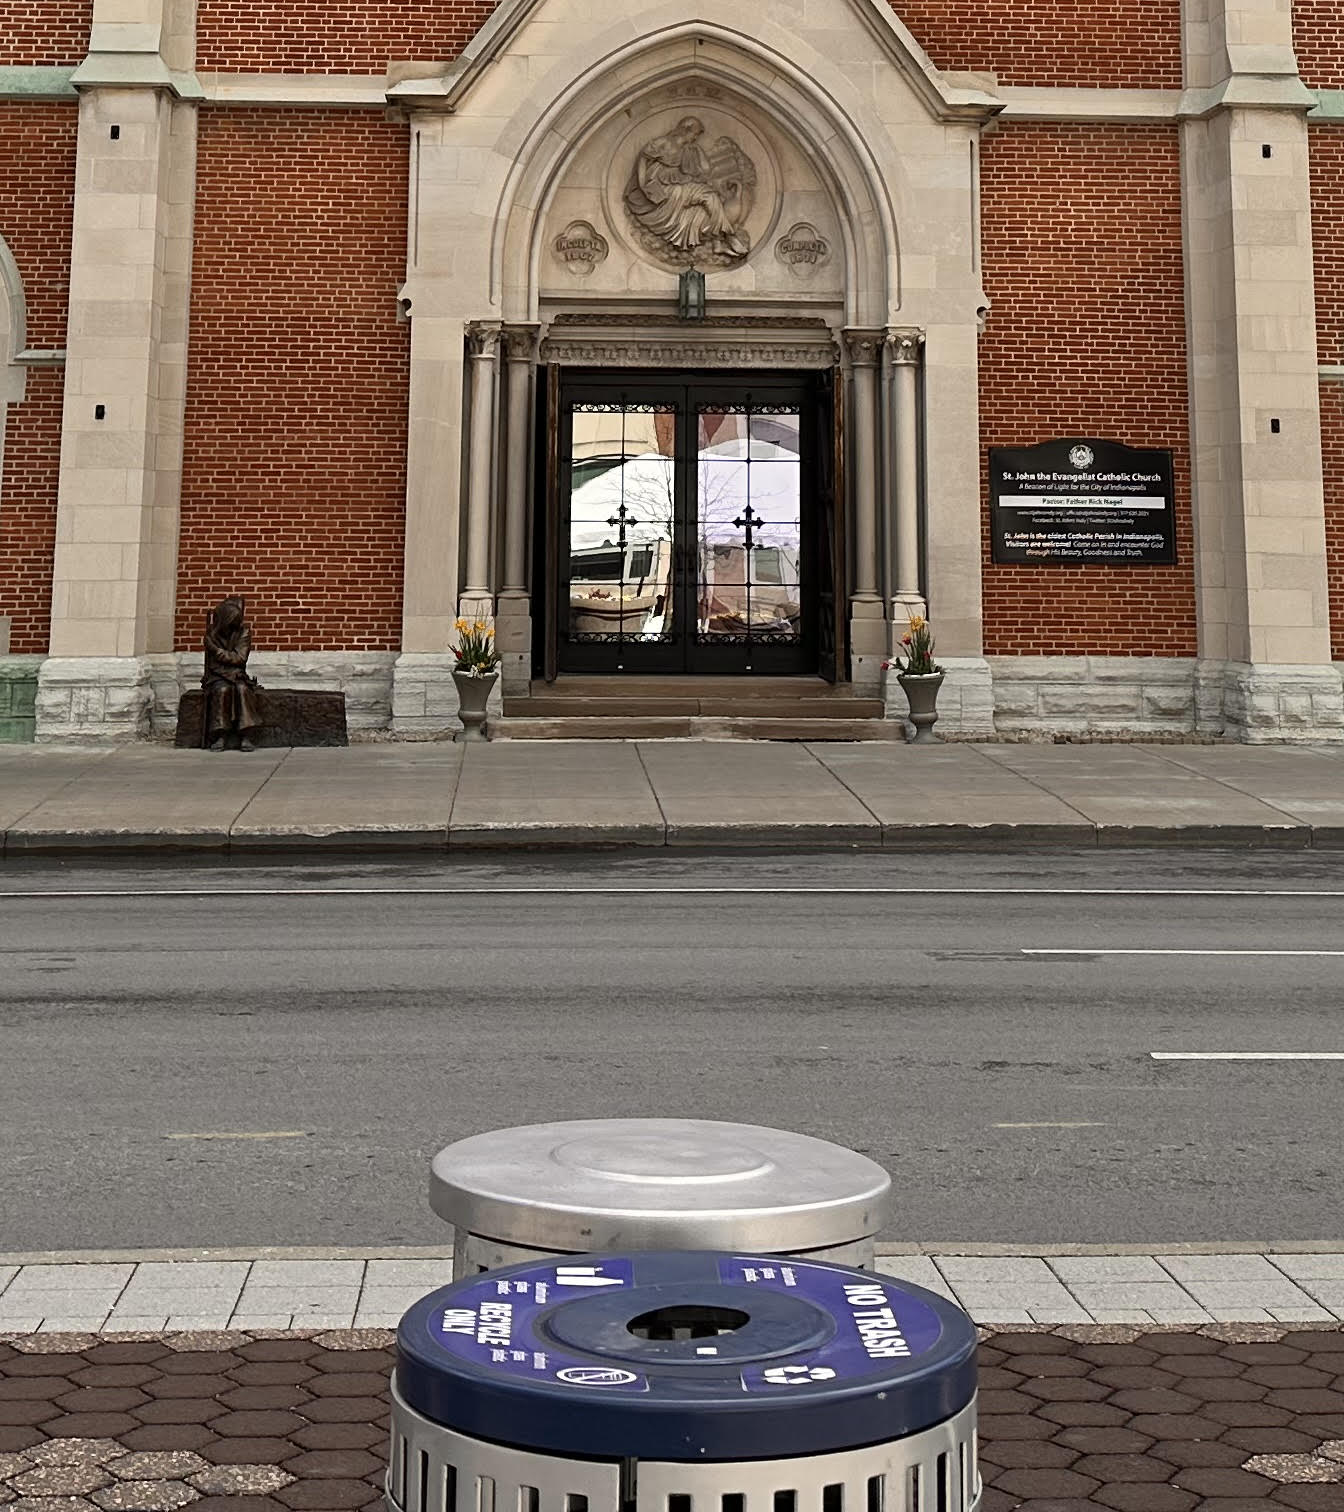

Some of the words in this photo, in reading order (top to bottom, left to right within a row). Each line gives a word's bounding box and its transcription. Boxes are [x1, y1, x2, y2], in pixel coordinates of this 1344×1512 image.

[1002, 472, 1014, 480] St.
[1015, 472, 1035, 481] John
[1036, 472, 1051, 481] the
[1052, 472, 1095, 483] Evangelist
[1096, 472, 1131, 481] Catholic
[1132, 472, 1161, 481] Church
[842, 1284, 887, 1306] NO
[441, 1308, 477, 1336] ONLY
[477, 1301, 513, 1346] RECYCLE
[853, 1307, 911, 1358] TRASH
